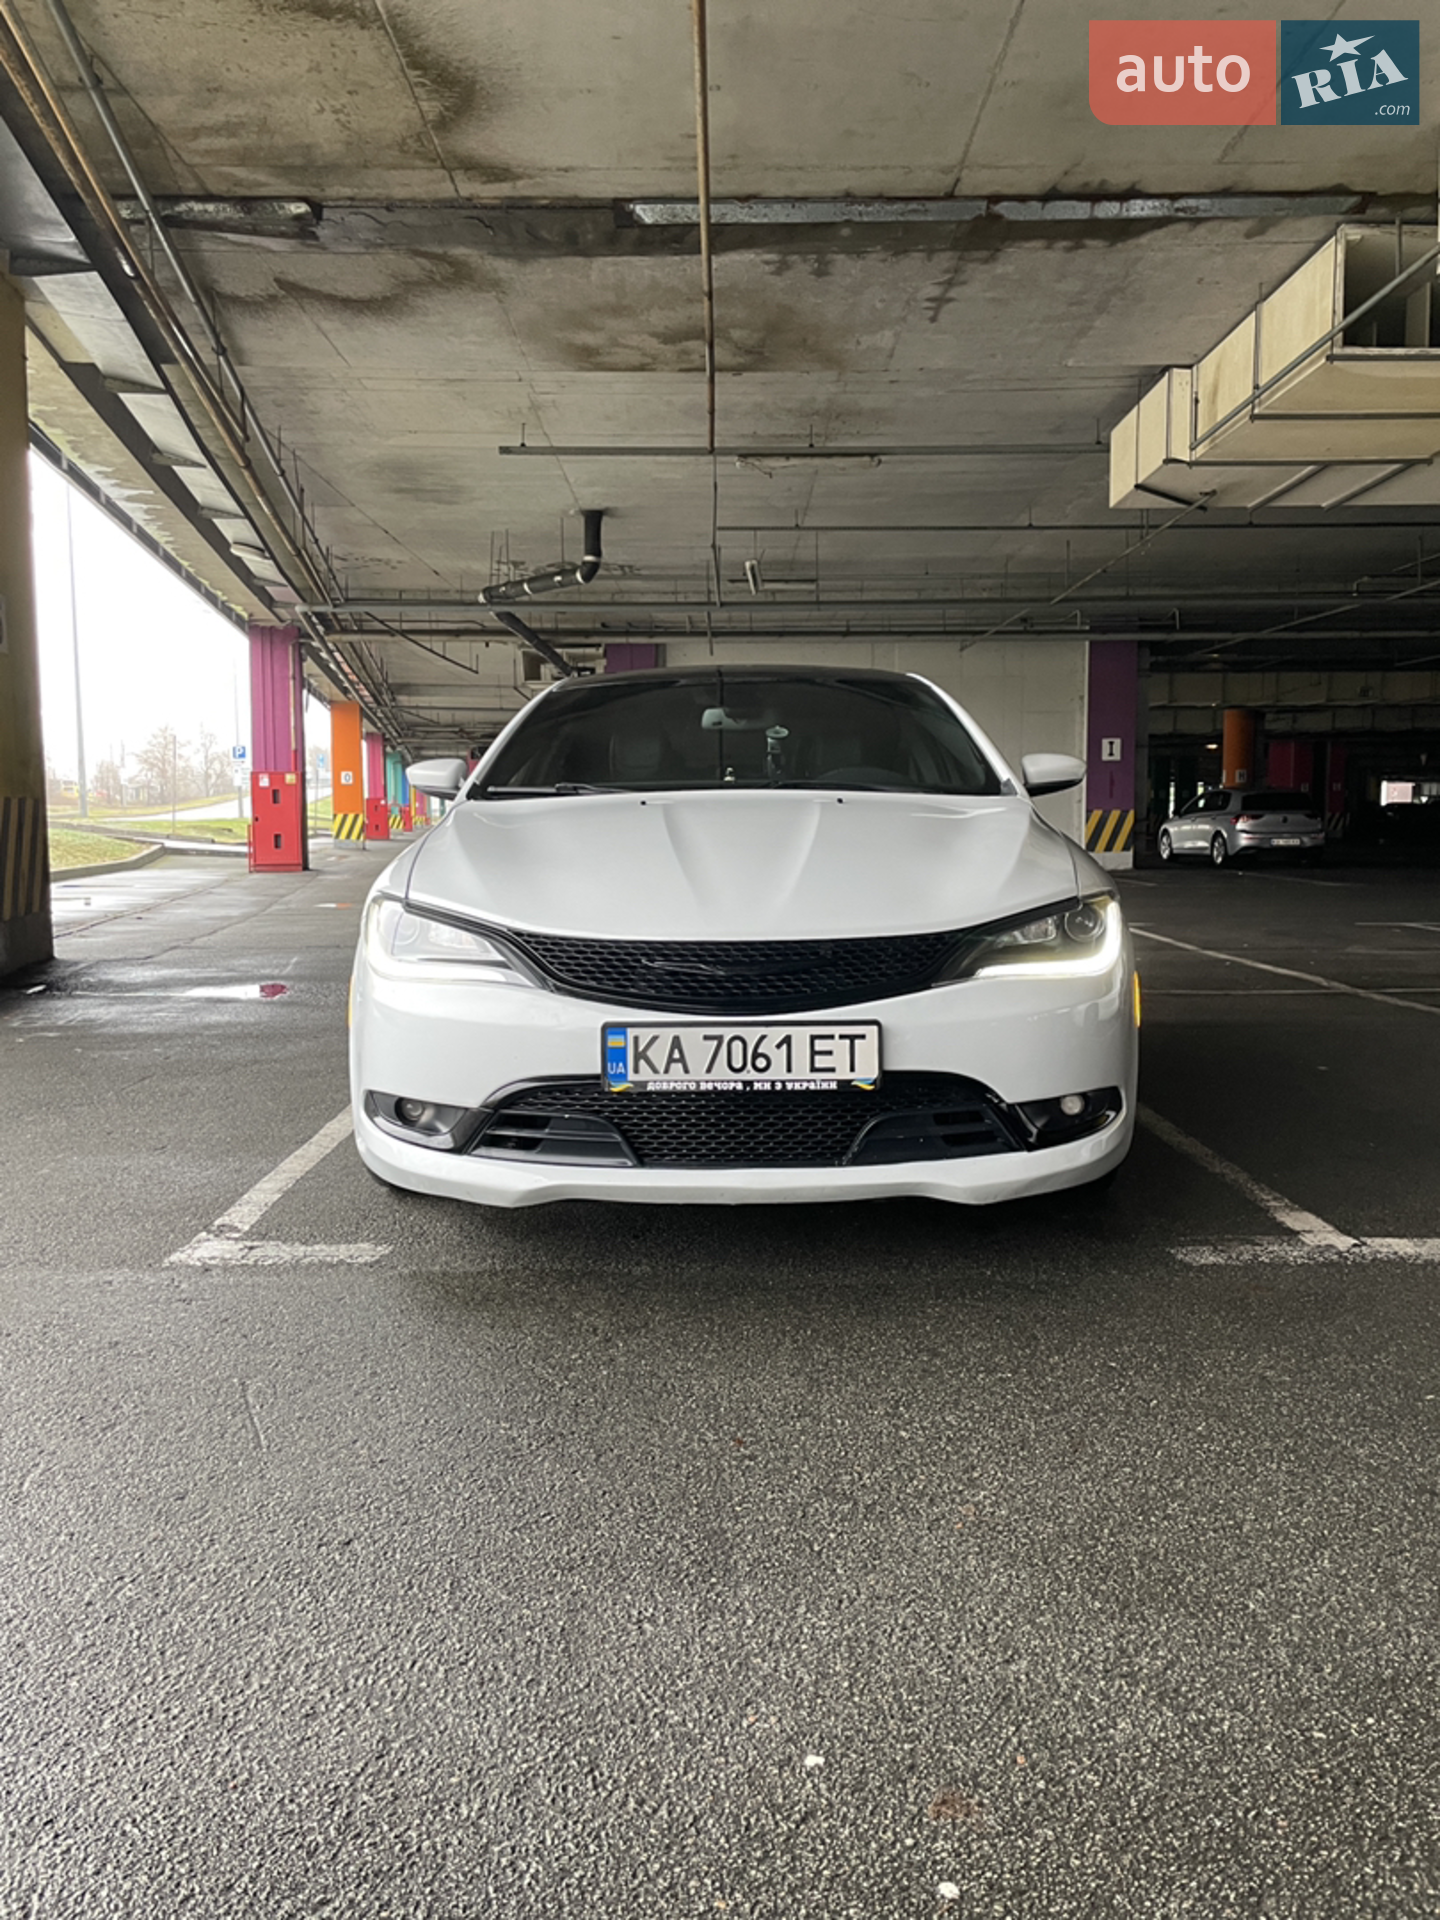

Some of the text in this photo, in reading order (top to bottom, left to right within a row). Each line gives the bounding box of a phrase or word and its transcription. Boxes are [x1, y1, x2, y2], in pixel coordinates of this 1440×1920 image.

[632, 1033, 867, 1074] KA 7061 ET
[607, 1062, 626, 1075] UA
